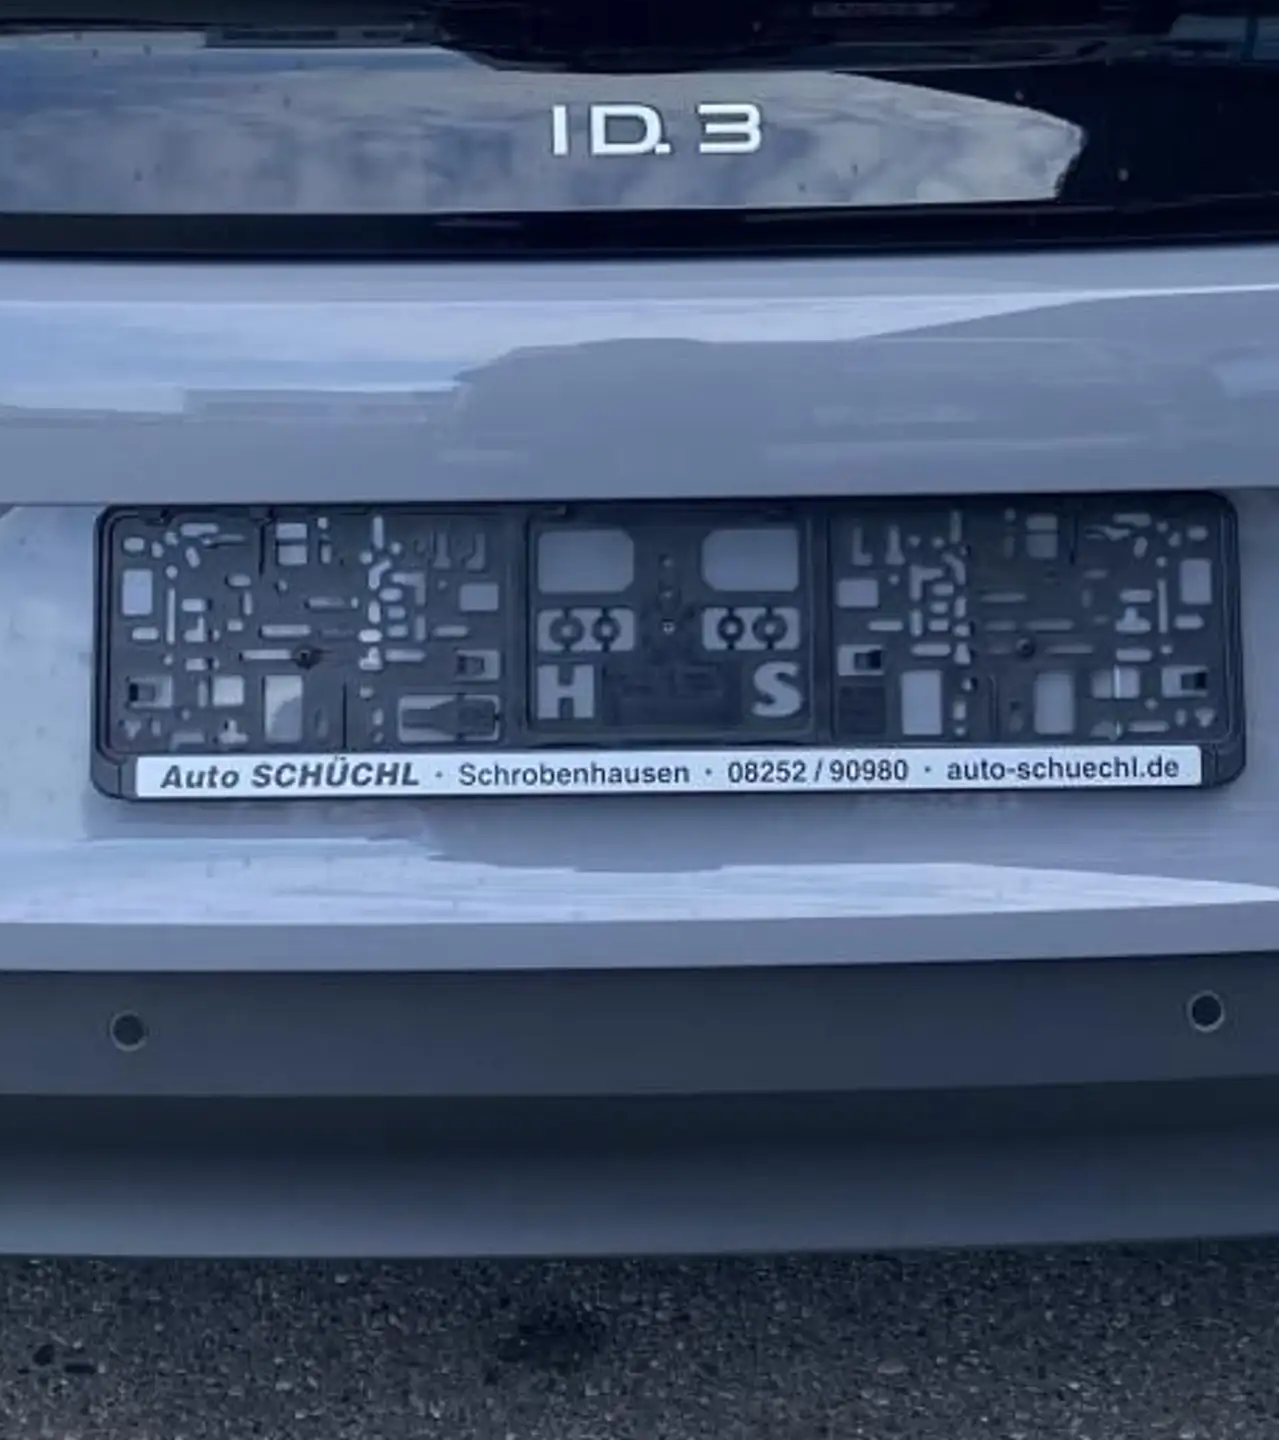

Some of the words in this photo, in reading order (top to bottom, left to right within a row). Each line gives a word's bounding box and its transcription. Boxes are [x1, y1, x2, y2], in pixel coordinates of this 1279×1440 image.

[160, 764, 239, 789] Auto
[251, 756, 420, 788] SCHÜCHL
[459, 763, 690, 786] Schrobenhausen
[727, 759, 807, 784] 08252
[829, 758, 910, 782] 90980
[947, 755, 1179, 781] auto-schuechl.de
